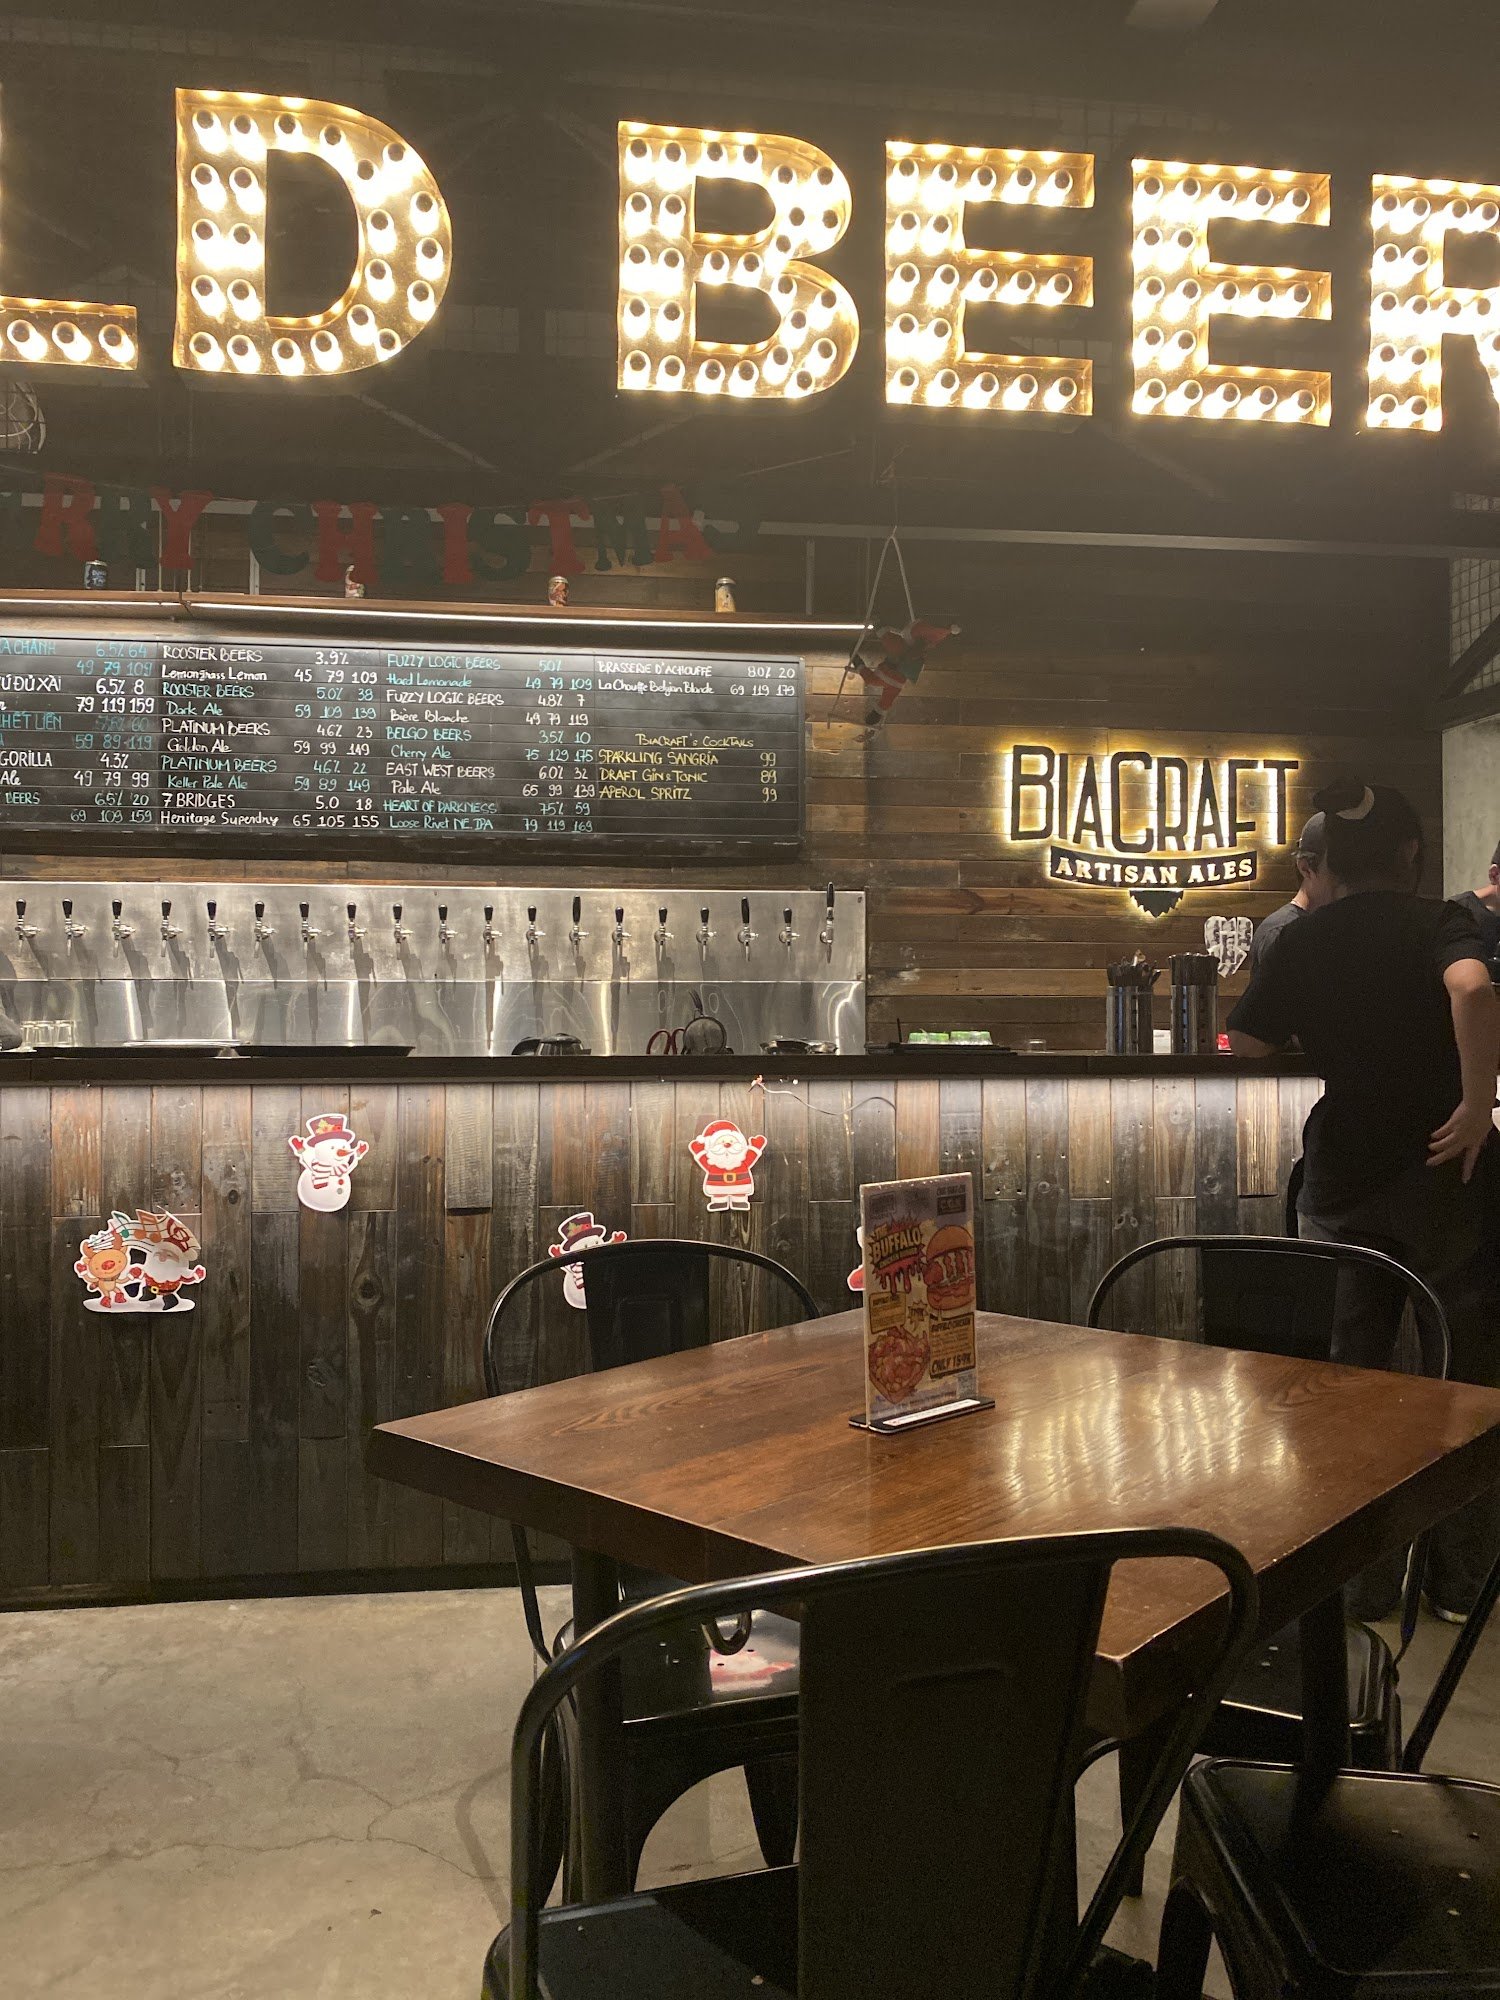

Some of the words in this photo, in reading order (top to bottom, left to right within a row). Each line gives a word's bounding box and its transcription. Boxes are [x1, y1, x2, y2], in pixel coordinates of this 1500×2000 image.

[617, 121, 1500, 432] BEER
[128, 643, 147, 657] 64
[163, 645, 217, 660] ROOSTER
[220, 648, 263, 662] BEERS
[315, 650, 349, 664] 3.9%
[76, 660, 94, 675] 49
[104, 662, 121, 675] 79
[126, 662, 152, 676] 109
[387, 654, 424, 667] FUZZY
[428, 656, 462, 668] LOGIC
[465, 657, 500, 669] BEERS
[597, 661, 652, 674] BRASSERIE
[779, 667, 796, 679] 20
[161, 664, 226, 681] Lemongrass
[228, 667, 267, 681] Lemon
[294, 669, 312, 682] 45
[326, 670, 344, 682] 79
[351, 671, 377, 684] 109
[387, 672, 413, 685] Hard
[417, 673, 472, 687] Lemonade
[526, 677, 541, 689] 49
[549, 677, 563, 689] 79
[569, 679, 592, 690] 109
[96, 678, 125, 694] 6.5%
[133, 679, 144, 695] 8
[162, 682, 212, 697] ROOSTER
[216, 685, 255, 698] BEERS
[358, 689, 373, 700] 38
[730, 684, 744, 695] 69
[752, 685, 769, 696] 119
[776, 684, 795, 696] 179
[76, 697, 94, 712] 79
[101, 698, 125, 713] 119
[129, 698, 155, 713] 159
[386, 690, 423, 702] FUZZY
[427, 691, 463, 703] LOGIC
[467, 693, 504, 705] BEERS
[577, 694, 585, 707] 7
[166, 701, 197, 715] Dark
[202, 703, 223, 715] Ale
[295, 704, 311, 718] 59
[320, 706, 342, 718] 109
[352, 708, 376, 719] 139
[390, 708, 419, 721] Bière
[425, 710, 469, 722] Blanche
[526, 712, 541, 725] 49
[547, 713, 561, 725] 79
[568, 714, 589, 725] 119
[161, 718, 225, 734] PLATINUM
[227, 721, 271, 735] BEERS
[356, 726, 373, 738] 23
[386, 726, 428, 740] BELGO
[433, 728, 472, 740] BEERS
[574, 732, 591, 744] 10
[75, 734, 93, 749] 59
[103, 734, 121, 749] 89
[129, 735, 152, 750] 119
[167, 737, 208, 752] Golden
[211, 739, 232, 752] Ale
[293, 741, 310, 754] 59
[320, 742, 336, 755] 99
[346, 743, 370, 755] 149
[100, 753, 129, 768] 4.3%
[391, 745, 426, 761] Cherry
[432, 745, 451, 758] Ale
[525, 749, 539, 760] 75
[548, 749, 569, 761] 129
[574, 749, 593, 762] 175
[599, 749, 662, 764] SPARKLING
[760, 752, 777, 766] 99
[161, 755, 230, 771] PLATINUM
[233, 759, 277, 772] BEERS
[353, 762, 367, 774] 22
[386, 762, 418, 776] EAST
[423, 764, 453, 777] WEST
[457, 766, 495, 779] BEERS
[574, 768, 588, 779] 32
[0, 770, 21, 785] Ale
[73, 771, 92, 786] 49
[103, 772, 121, 787] 79
[132, 772, 149, 787] 99
[168, 775, 198, 788] Keller
[202, 774, 224, 788] Pale
[228, 775, 248, 789] Ale
[294, 776, 310, 791] 59
[318, 778, 337, 791] 89
[346, 779, 370, 792] 149
[600, 768, 637, 781] DRAFT
[760, 769, 777, 784] 89
[391, 779, 417, 793] Pale
[421, 780, 441, 794] Ale
[522, 784, 538, 796] 65
[549, 785, 562, 796] 99
[574, 785, 595, 798] 139
[599, 785, 646, 799] APEROL
[762, 787, 777, 802] 99
[132, 794, 149, 805] 20
[162, 793, 172, 808] 7
[176, 792, 235, 808] BRIDGES
[316, 795, 339, 809] 5.0
[356, 798, 372, 810] 18
[383, 800, 419, 812] HEART
[422, 801, 434, 812] OF
[438, 801, 497, 813] DARKNESS
[575, 803, 590, 815] 59
[1011, 745, 1299, 853] BIACRAFT
[71, 810, 87, 821] 69
[98, 810, 123, 823] 109
[130, 810, 152, 823] 159
[160, 811, 216, 825] Heritage
[221, 812, 279, 826] Superdry
[293, 815, 311, 826] 65
[317, 815, 345, 827] 105
[352, 816, 379, 827] 155
[390, 816, 419, 828] Loose
[424, 815, 449, 828] Rivet
[523, 819, 538, 831] 79
[547, 820, 565, 831] 119
[572, 821, 592, 833] 169
[1056, 857, 1178, 884] ARTISAN
[1187, 858, 1254, 884] ALES
[873, 1227, 922, 1262] BUFFALO
